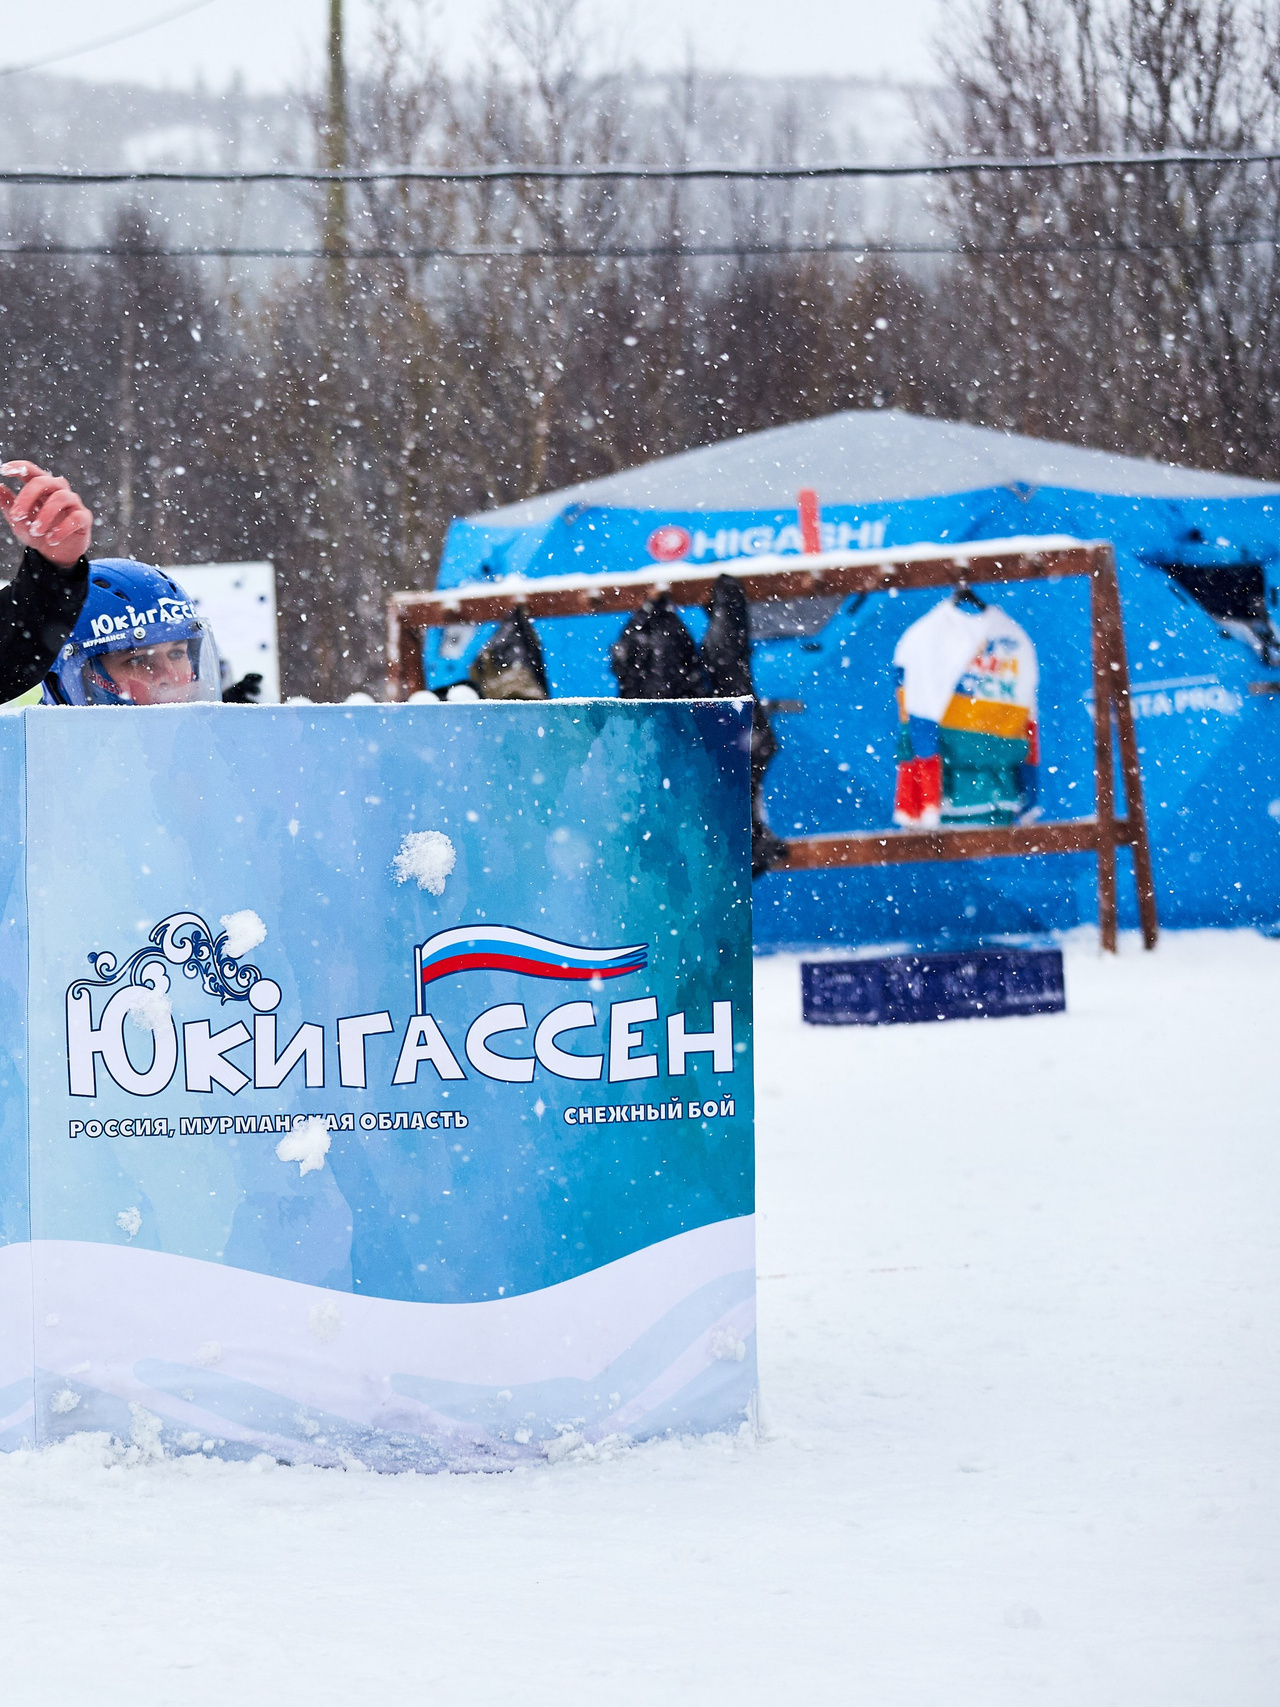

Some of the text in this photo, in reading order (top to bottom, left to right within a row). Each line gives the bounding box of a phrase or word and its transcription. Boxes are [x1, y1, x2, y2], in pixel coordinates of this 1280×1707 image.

[692, 519, 887, 558] HIGASHI
[82, 632, 127, 648] МУРМАНСК
[69, 1117, 176, 1138] РОССИЯ,
[358, 1110, 469, 1131] ОБЛАСТЬ
[563, 1093, 736, 1126] СНЕЖНЫЙ БОЙ
